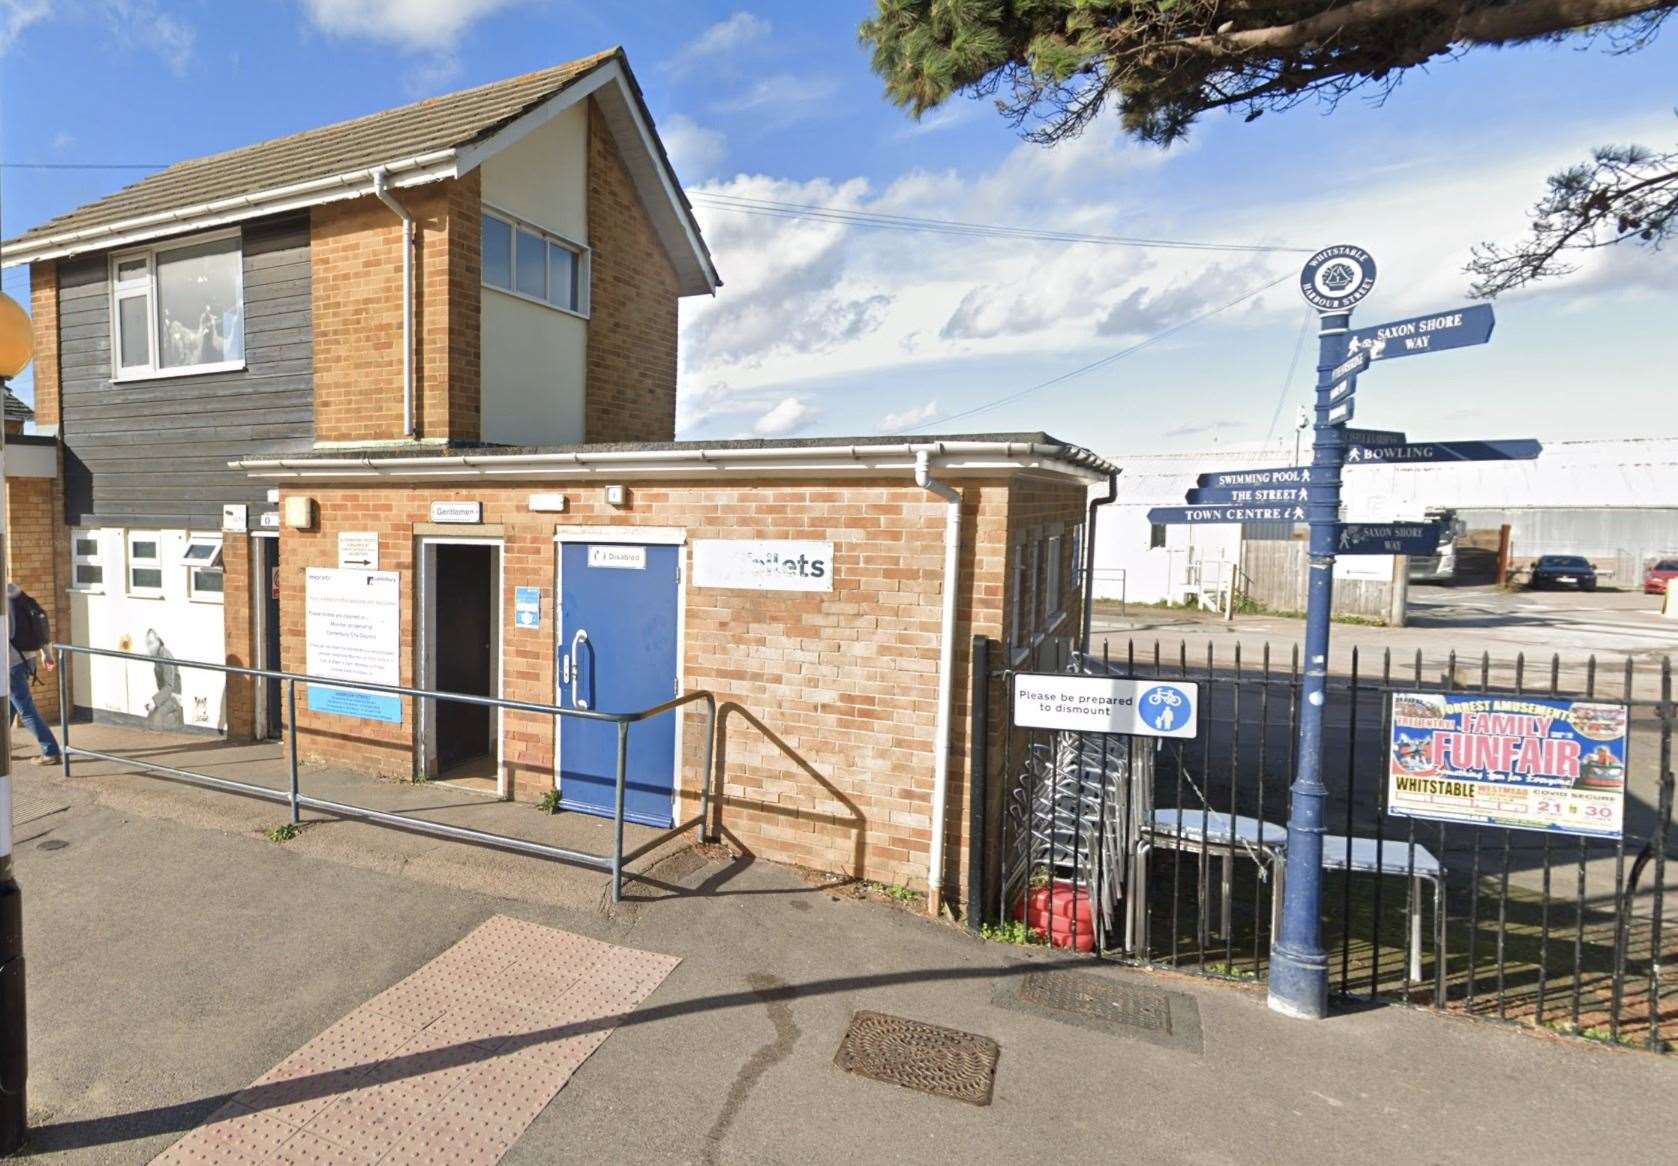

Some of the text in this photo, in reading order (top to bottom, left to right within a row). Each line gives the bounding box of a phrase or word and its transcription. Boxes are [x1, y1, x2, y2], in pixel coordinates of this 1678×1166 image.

[1308, 247, 1369, 267] WHITSTABLE
[1303, 278, 1373, 308] HARBOUR STREET
[1377, 314, 1463, 340] SAXON SHORE
[1404, 336, 1430, 350] WAY
[1363, 447, 1433, 460] BOWLING
[1219, 471, 1300, 486] SWIMMING POOL
[1231, 489, 1297, 501] THE STREET
[436, 506, 474, 517] Gentlemen
[1185, 510, 1222, 520] TOWN
[1226, 508, 1281, 520] CENTRE
[1363, 527, 1424, 538] SAXON SHORE
[1384, 540, 1402, 551] WAY
[608, 552, 640, 561] Disabled
[1019, 690, 1133, 706] Please be prepared
[1040, 703, 1111, 716] to dismount
[1461, 712, 1555, 739] FAMILY
[1432, 731, 1581, 778] FUNFAIR
[1397, 777, 1475, 798] WHITSTABLE
[1538, 801, 1561, 813] 21
[1584, 805, 1612, 818] 30
